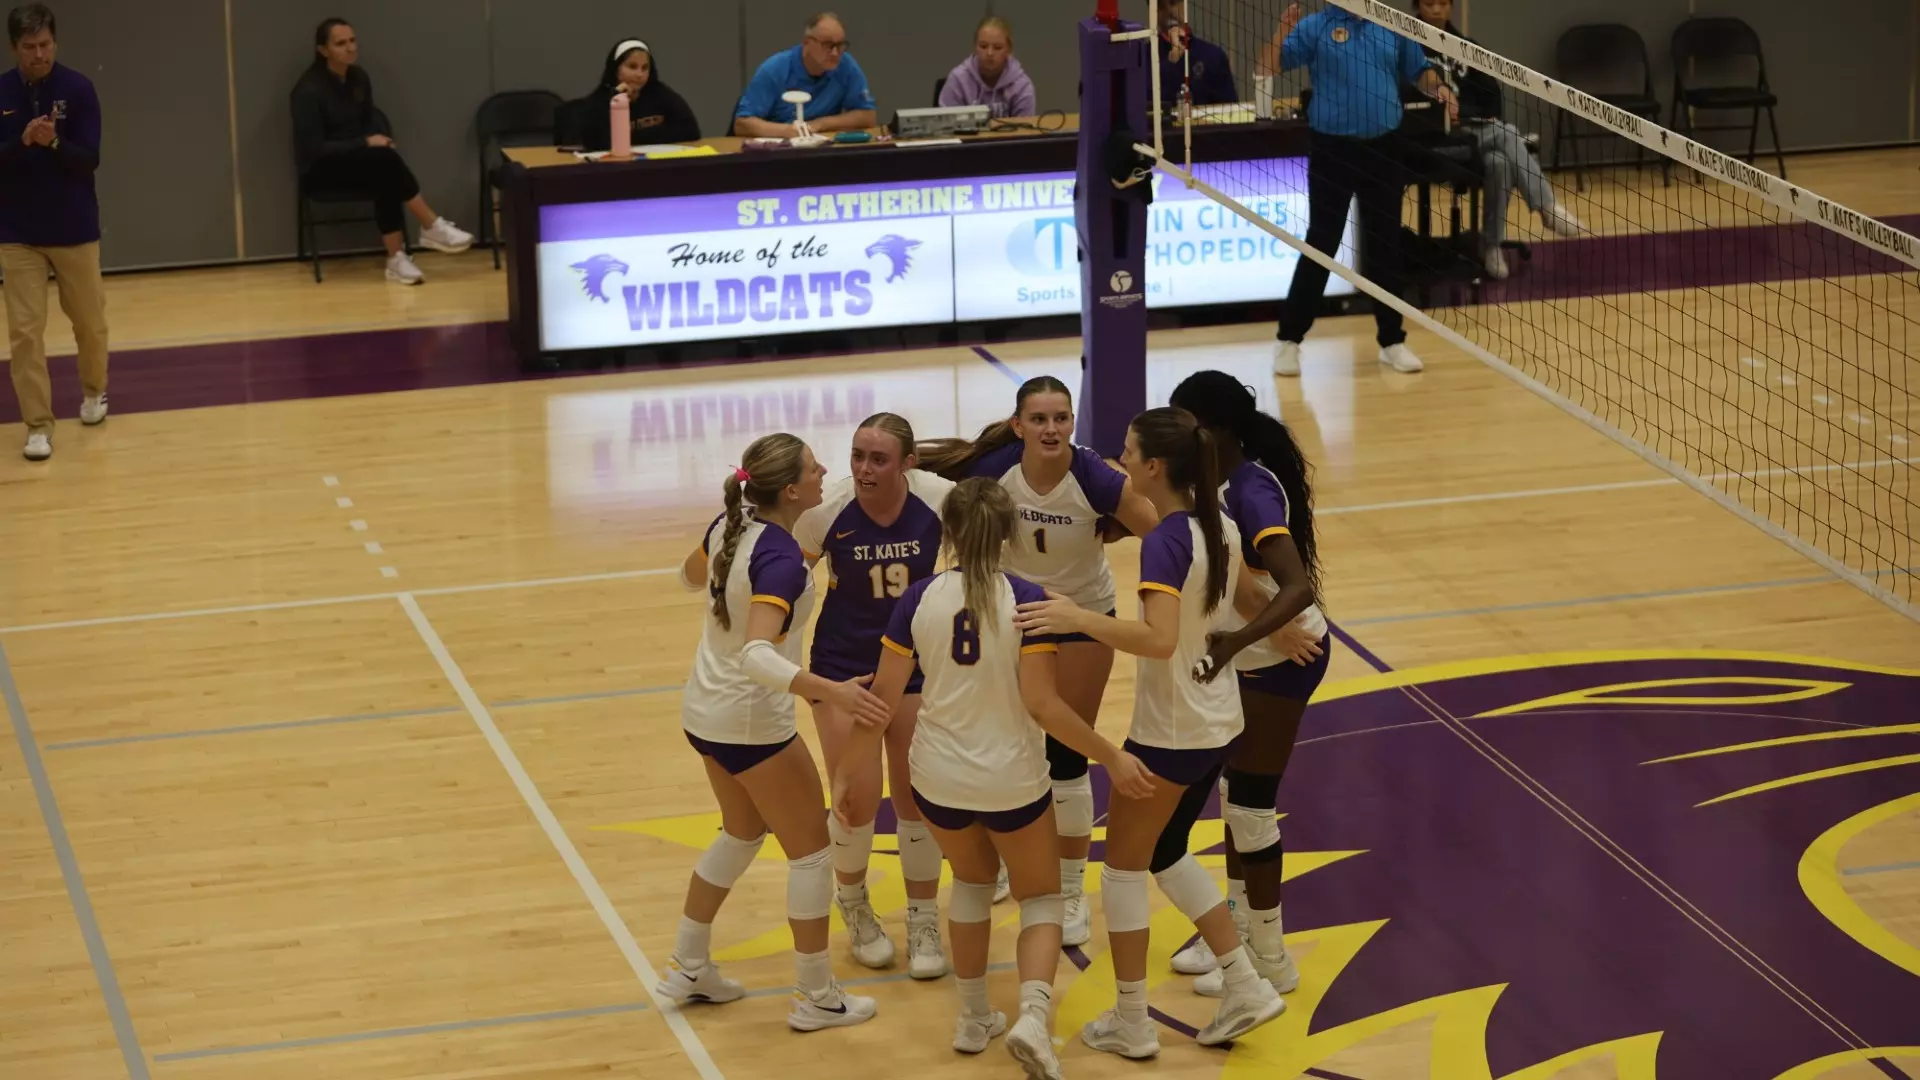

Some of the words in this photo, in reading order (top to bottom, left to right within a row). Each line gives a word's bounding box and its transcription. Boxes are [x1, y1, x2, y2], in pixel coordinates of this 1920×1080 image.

[1460, 41, 1471, 60] ST.
[1492, 55, 1529, 87] VOLLEYBALL
[1567, 88, 1579, 109] ST.
[1579, 93, 1602, 120] KATE'S
[1602, 104, 1643, 138] VOLLEYBALL
[1686, 140, 1697, 163] ST.
[1699, 146, 1725, 174] KATE'S
[1725, 159, 1771, 195] VOLLEYBALL
[737, 198, 788, 226] ST.
[798, 184, 972, 222] CATHERINE
[1818, 200, 1831, 222] ST.
[1833, 204, 1861, 235] KATE'S
[1862, 217, 1914, 259] VOLLEYBALL
[667, 242, 744, 269] Home
[756, 239, 781, 269] of
[791, 235, 828, 260] the
[622, 269, 874, 332] WILDCATS
[1017, 286, 1075, 303] Sports
[854, 545, 873, 561] ST.
[876, 540, 921, 560] KATE'S
[1033, 528, 1047, 554] 1
[869, 563, 910, 599] 19
[951, 608, 981, 666] 8
